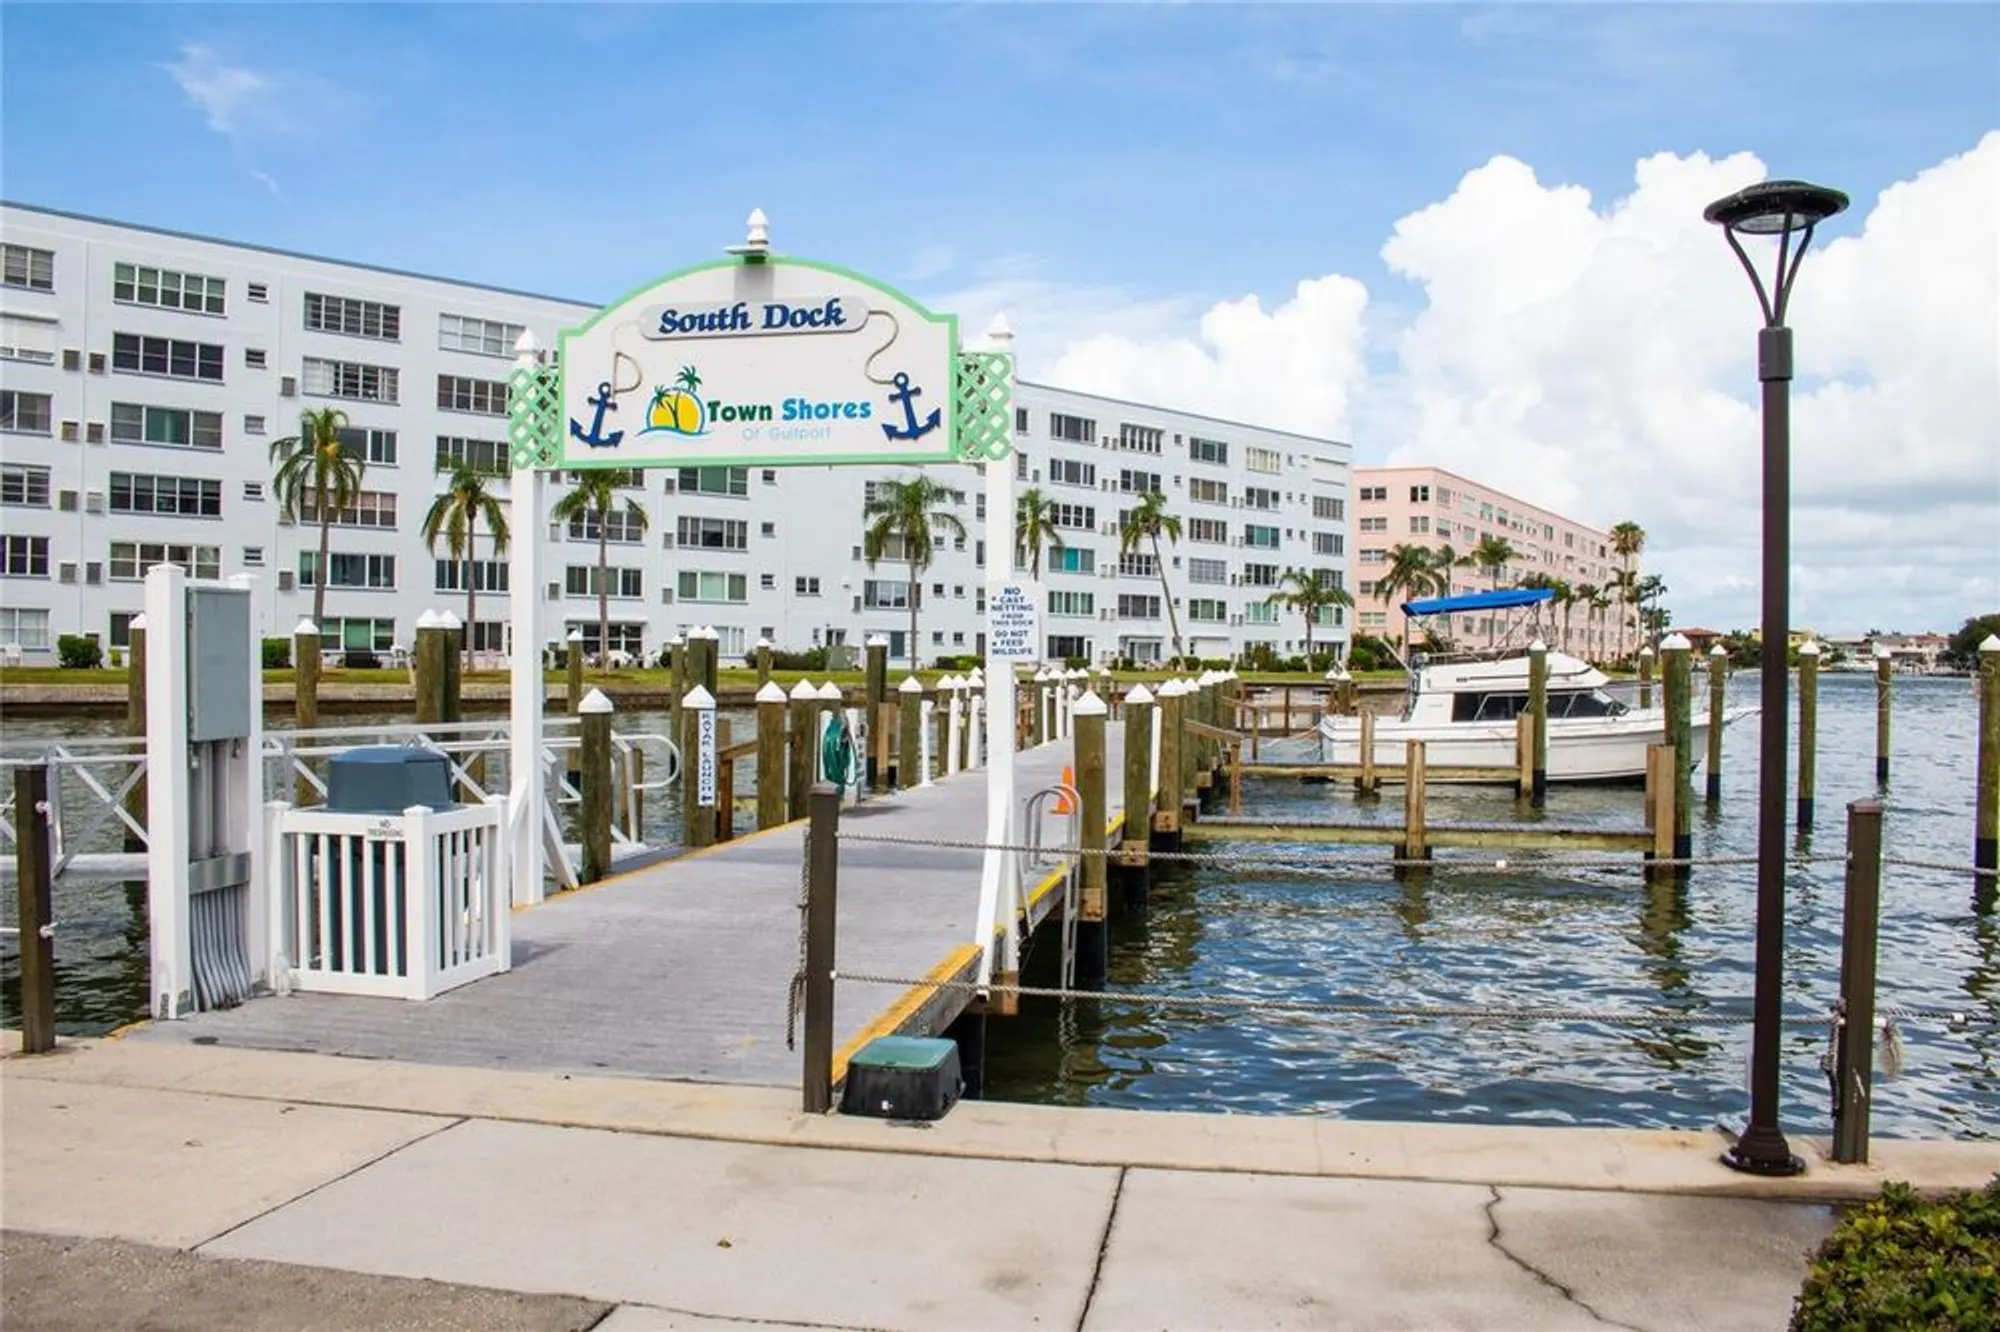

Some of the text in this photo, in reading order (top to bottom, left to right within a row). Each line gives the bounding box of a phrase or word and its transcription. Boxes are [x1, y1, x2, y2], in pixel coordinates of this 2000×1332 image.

[659, 298, 846, 334] South Dock
[707, 399, 872, 422] Town Shores
[1004, 587, 1021, 595] NO
